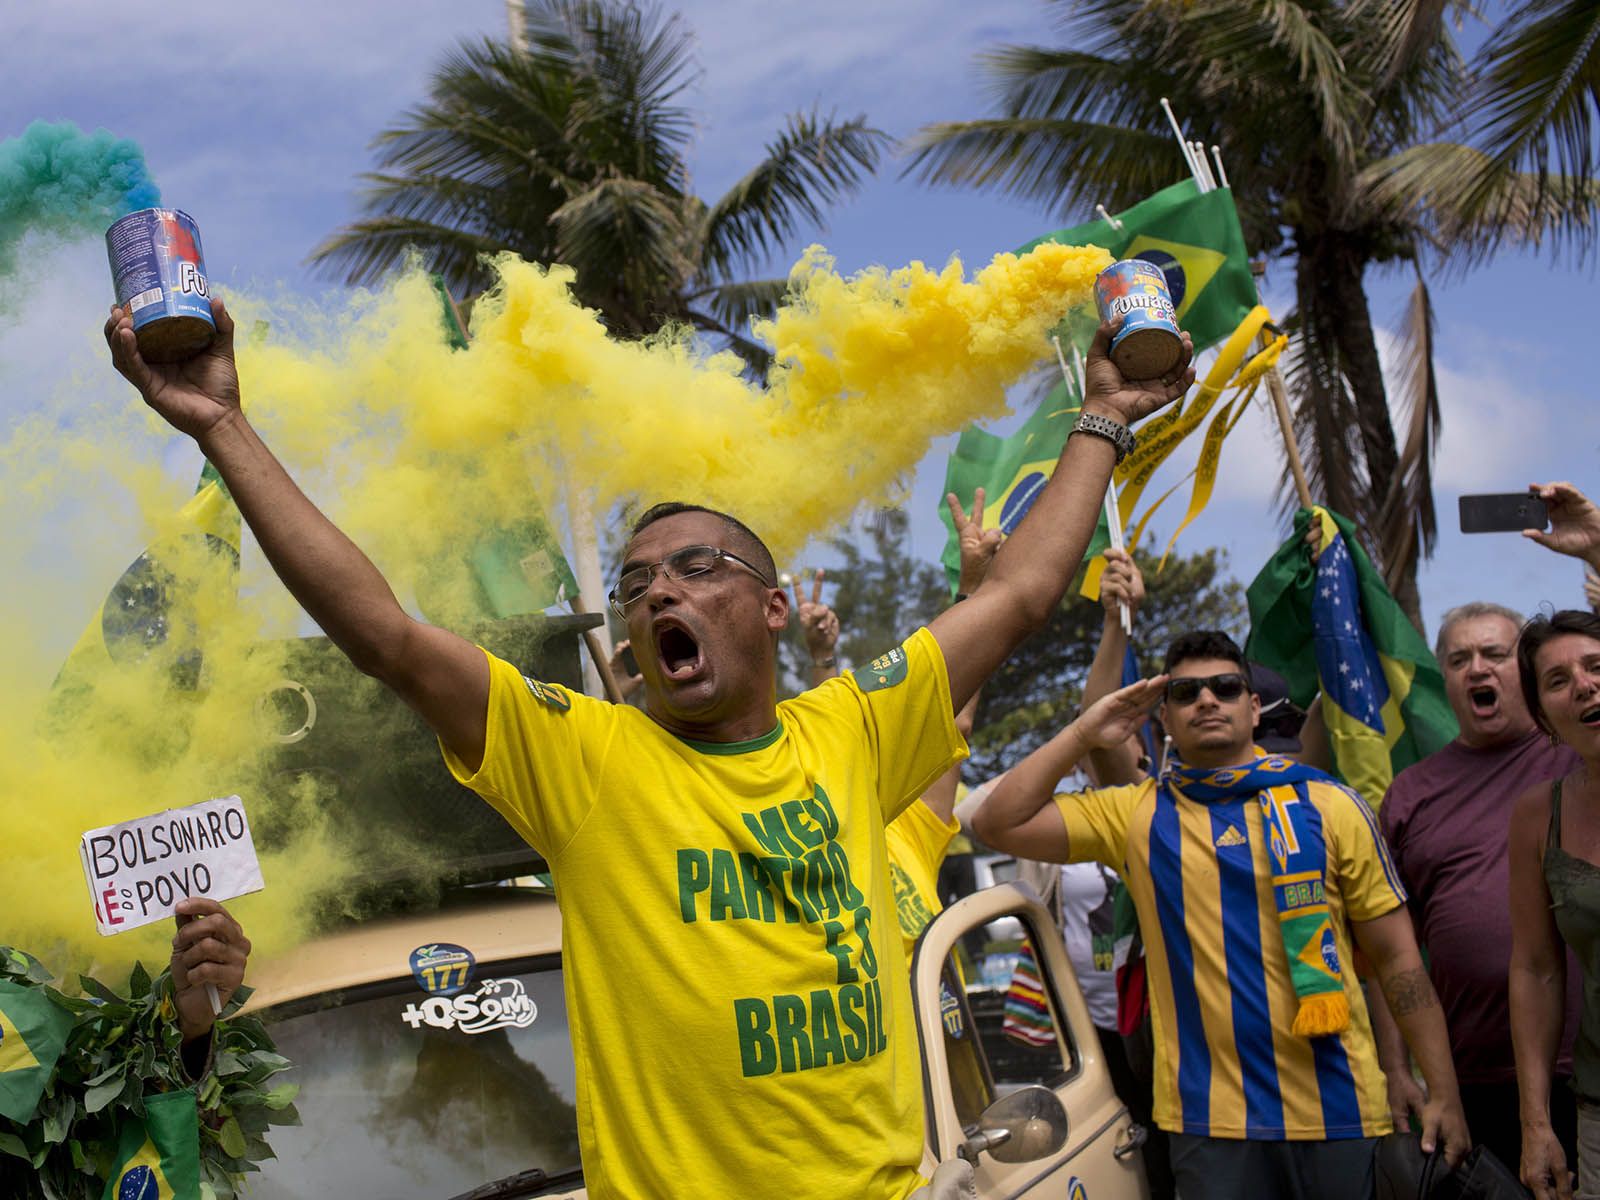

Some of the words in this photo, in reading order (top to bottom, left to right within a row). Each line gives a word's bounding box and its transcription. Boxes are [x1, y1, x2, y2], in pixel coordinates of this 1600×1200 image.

[180, 262, 209, 299] Fu
[90, 808, 244, 879] BOLSONARO
[741, 782, 840, 859] MEU
[103, 881, 124, 926] É
[135, 862, 212, 917] POVO
[676, 839, 864, 923] PARTIDO
[421, 961, 470, 991] 177
[733, 979, 887, 1078] BRASIL
